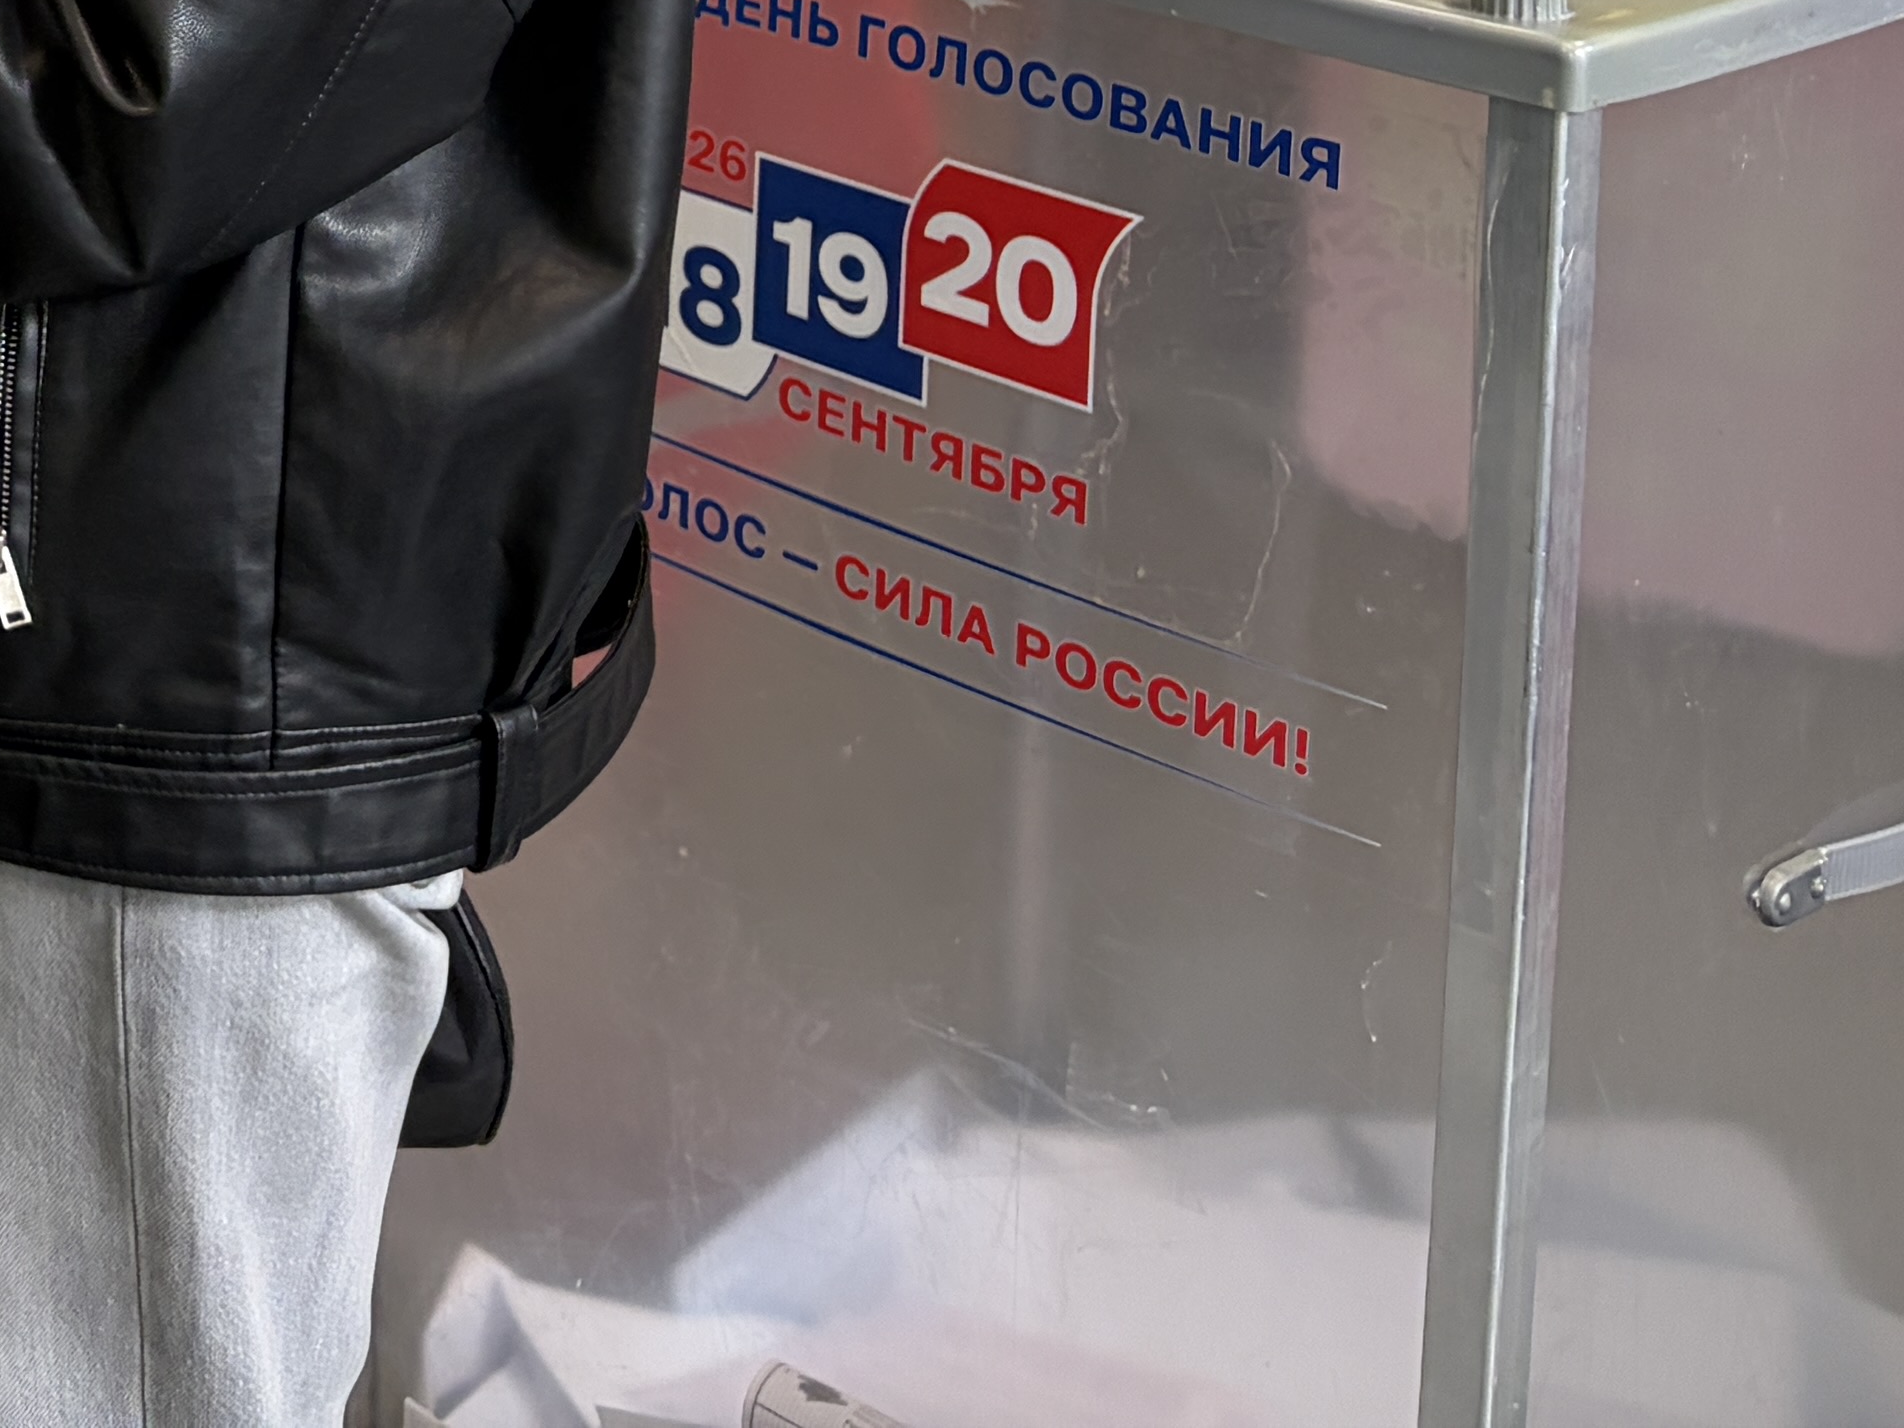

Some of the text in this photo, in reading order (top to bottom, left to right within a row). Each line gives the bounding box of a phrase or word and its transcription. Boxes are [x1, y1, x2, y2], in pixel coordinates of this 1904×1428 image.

[687, 129, 747, 182] 26
[857, 14, 1344, 191] ГОЛОСОВАНИЯ
[679, 245, 742, 346] 8
[772, 215, 890, 339] 19
[920, 209, 1079, 348] 20
[777, 376, 1090, 526] СЕНТЯБРЯ
[833, 553, 995, 656] СИЛА
[1015, 621, 1311, 778] РОССИИ!
